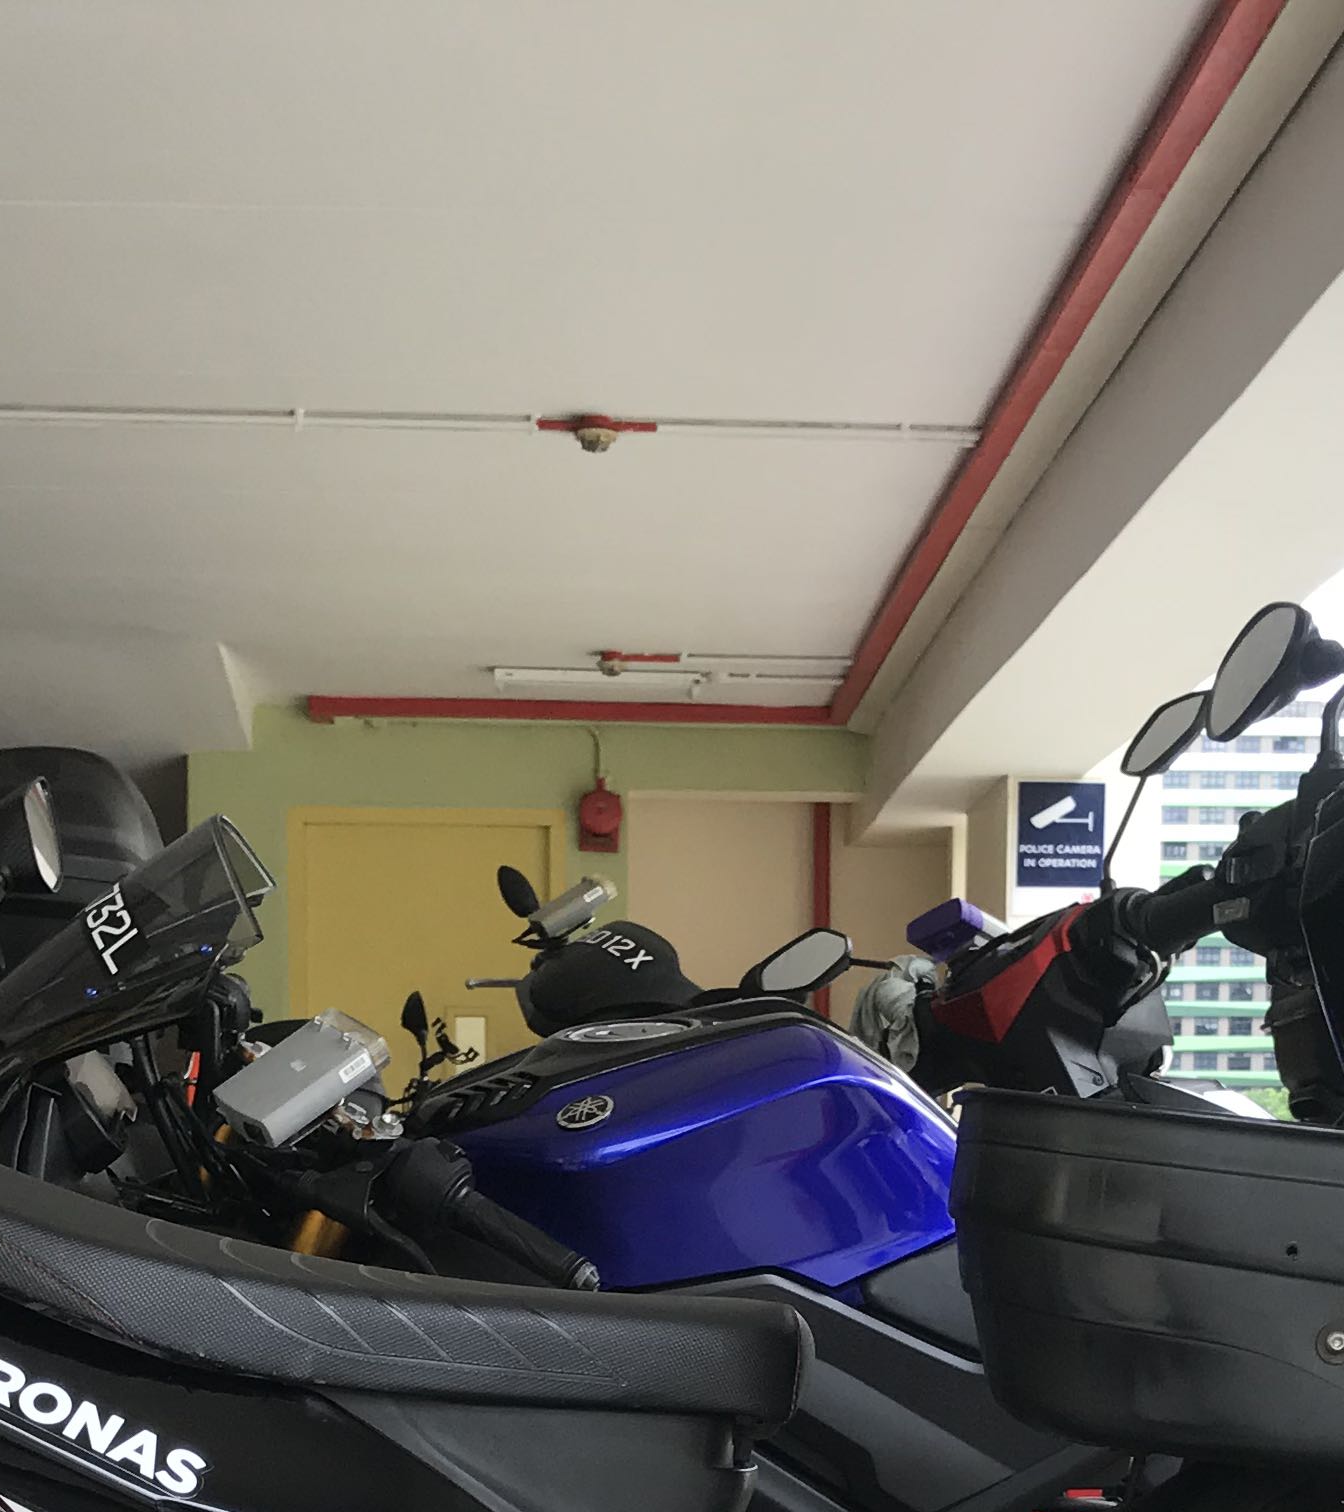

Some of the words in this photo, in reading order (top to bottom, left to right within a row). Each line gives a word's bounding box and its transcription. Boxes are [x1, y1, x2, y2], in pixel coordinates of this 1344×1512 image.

[1019, 844, 1054, 855] POLICE
[1056, 844, 1101, 855] CAMERA
[1023, 858, 1036, 868] IN
[1038, 858, 1097, 869] OPERATION
